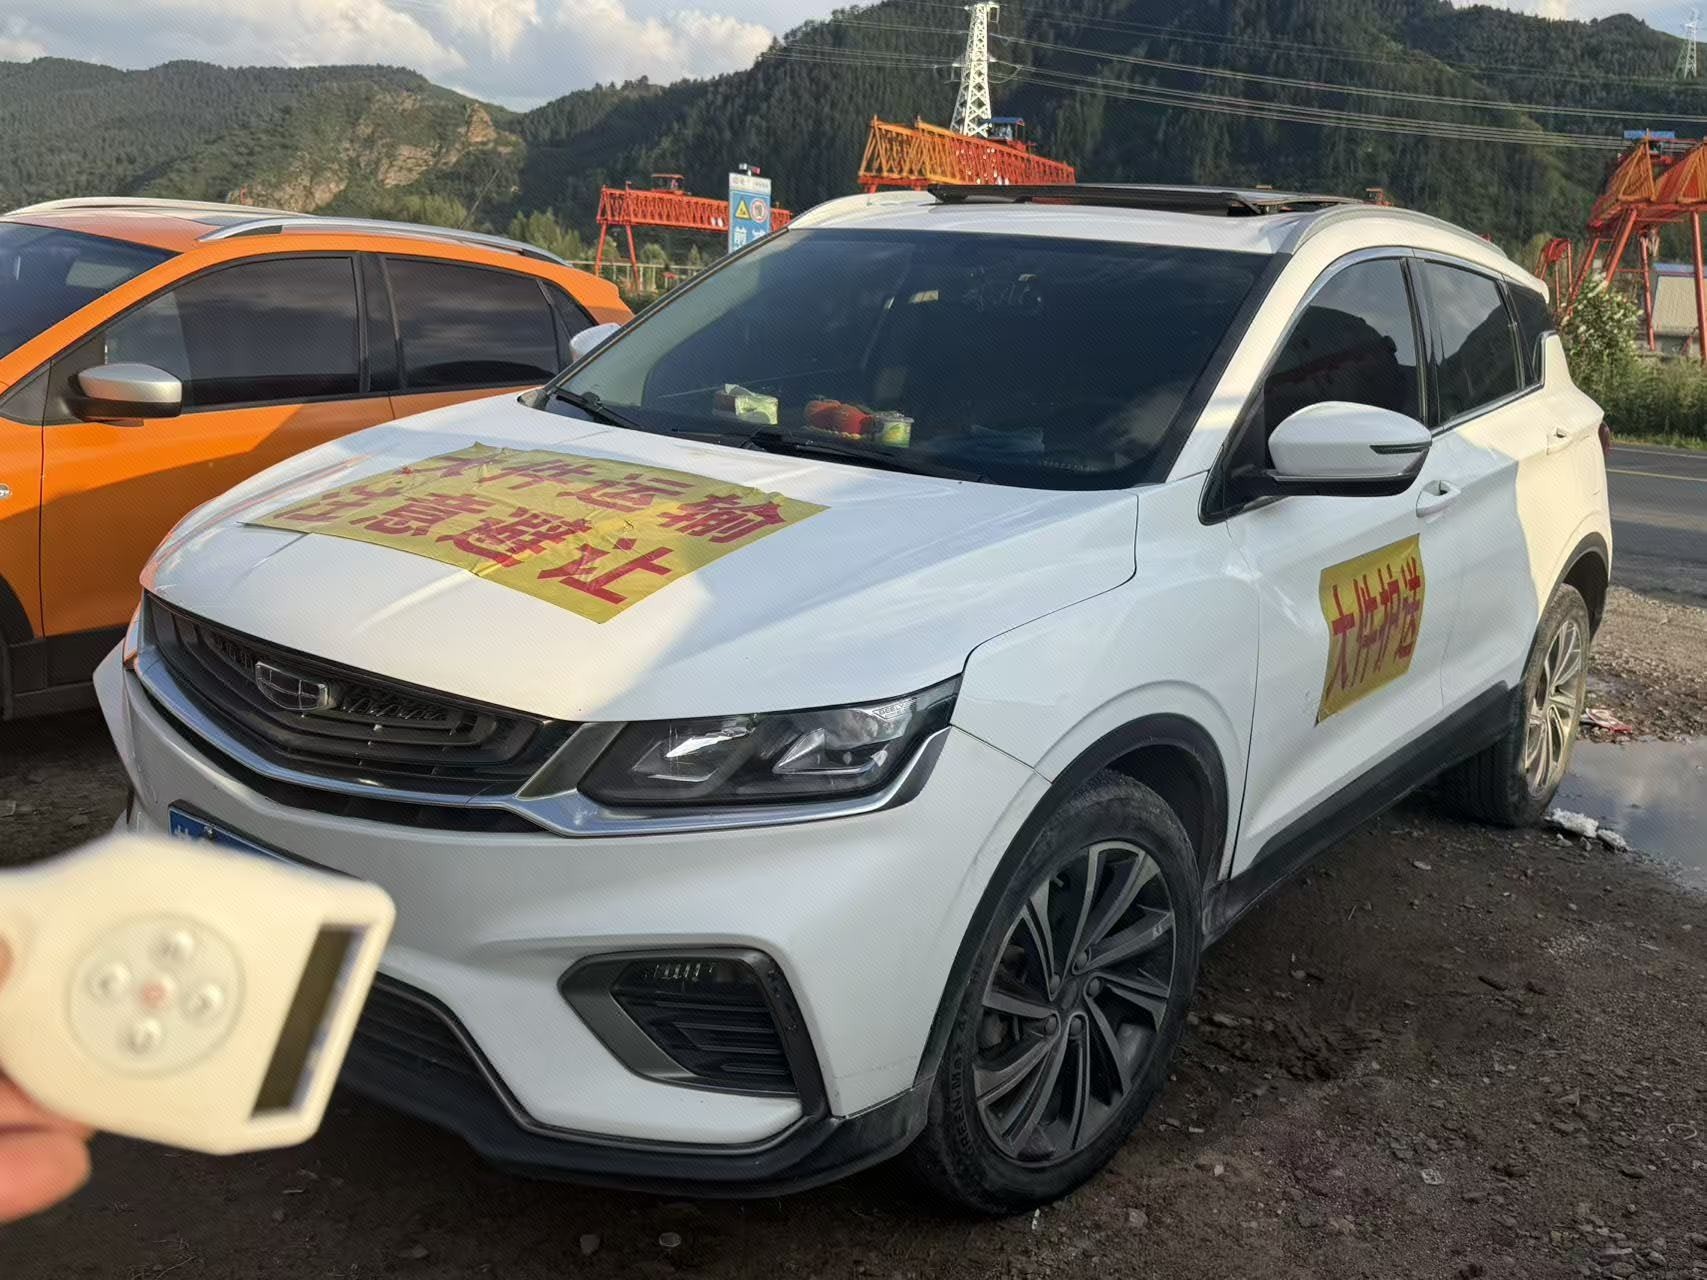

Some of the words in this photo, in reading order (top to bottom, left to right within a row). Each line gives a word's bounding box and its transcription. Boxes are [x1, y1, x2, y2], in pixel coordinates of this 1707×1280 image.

[285, 485, 673, 605] 注意避让
[390, 456, 787, 545] 大件运输
[1325, 556, 1421, 701] 大件护送
